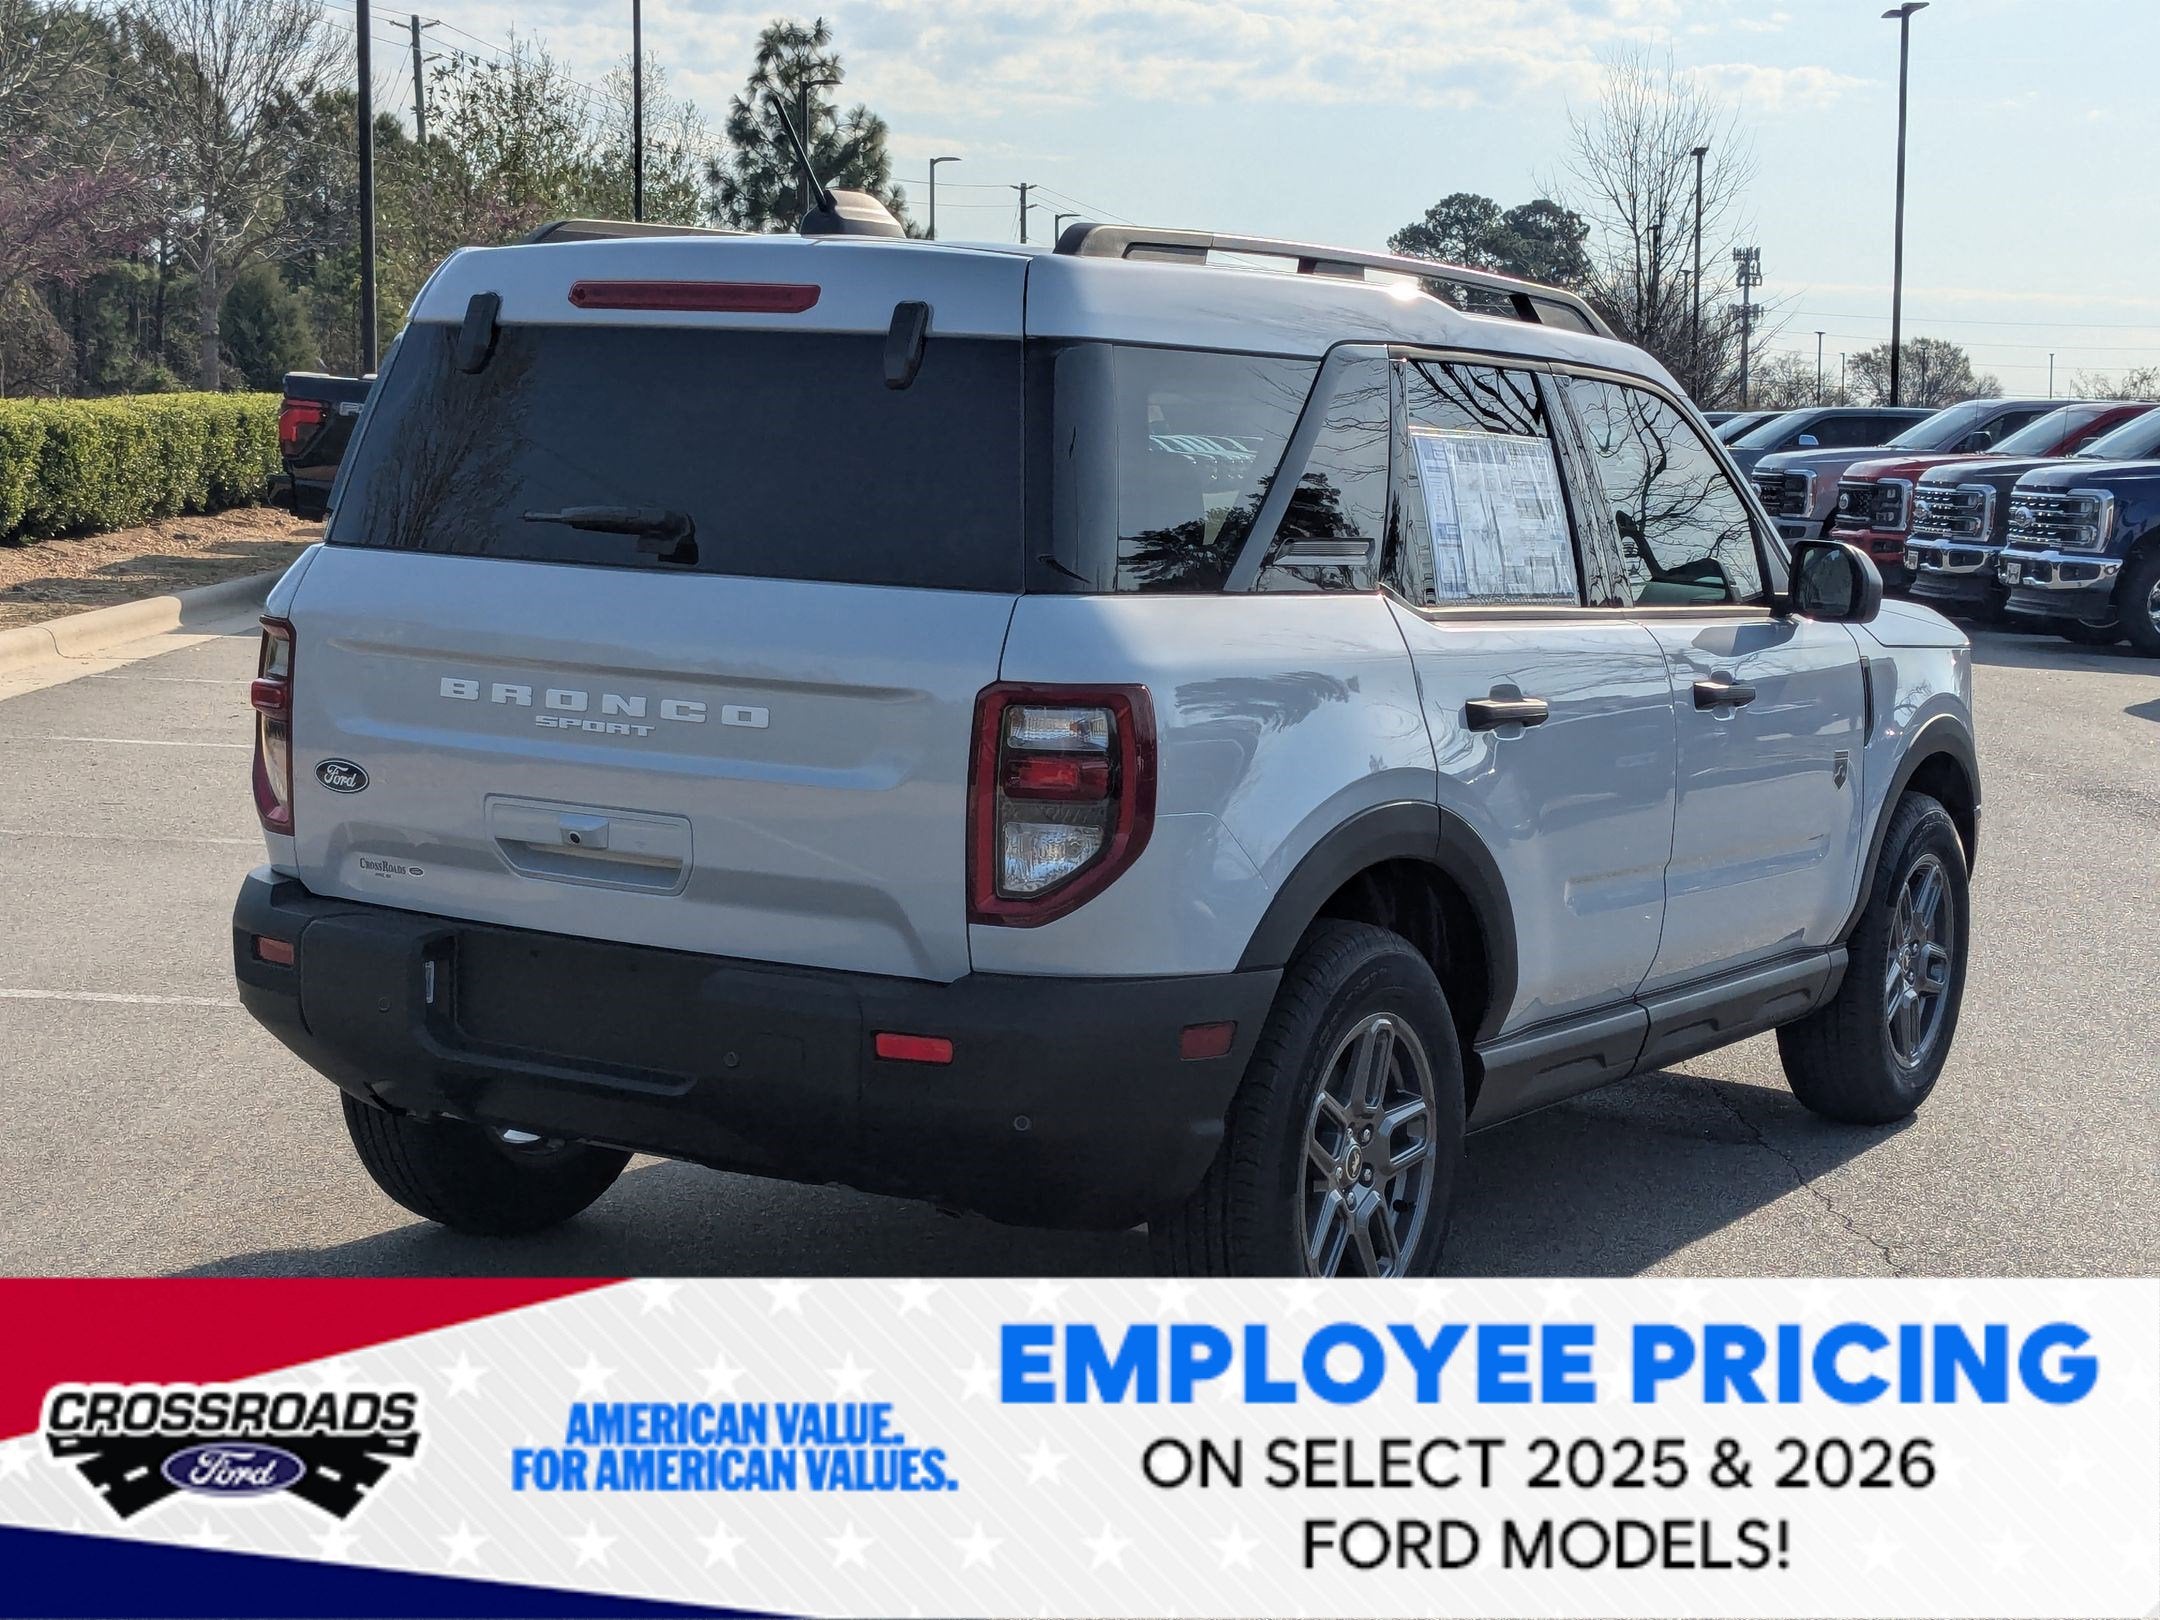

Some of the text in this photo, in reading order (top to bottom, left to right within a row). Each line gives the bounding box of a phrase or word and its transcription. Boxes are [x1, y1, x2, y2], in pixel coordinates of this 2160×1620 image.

[439, 676, 770, 730] BRONCO
[535, 714, 656, 738] SPORT
[324, 764, 357, 788] Ford
